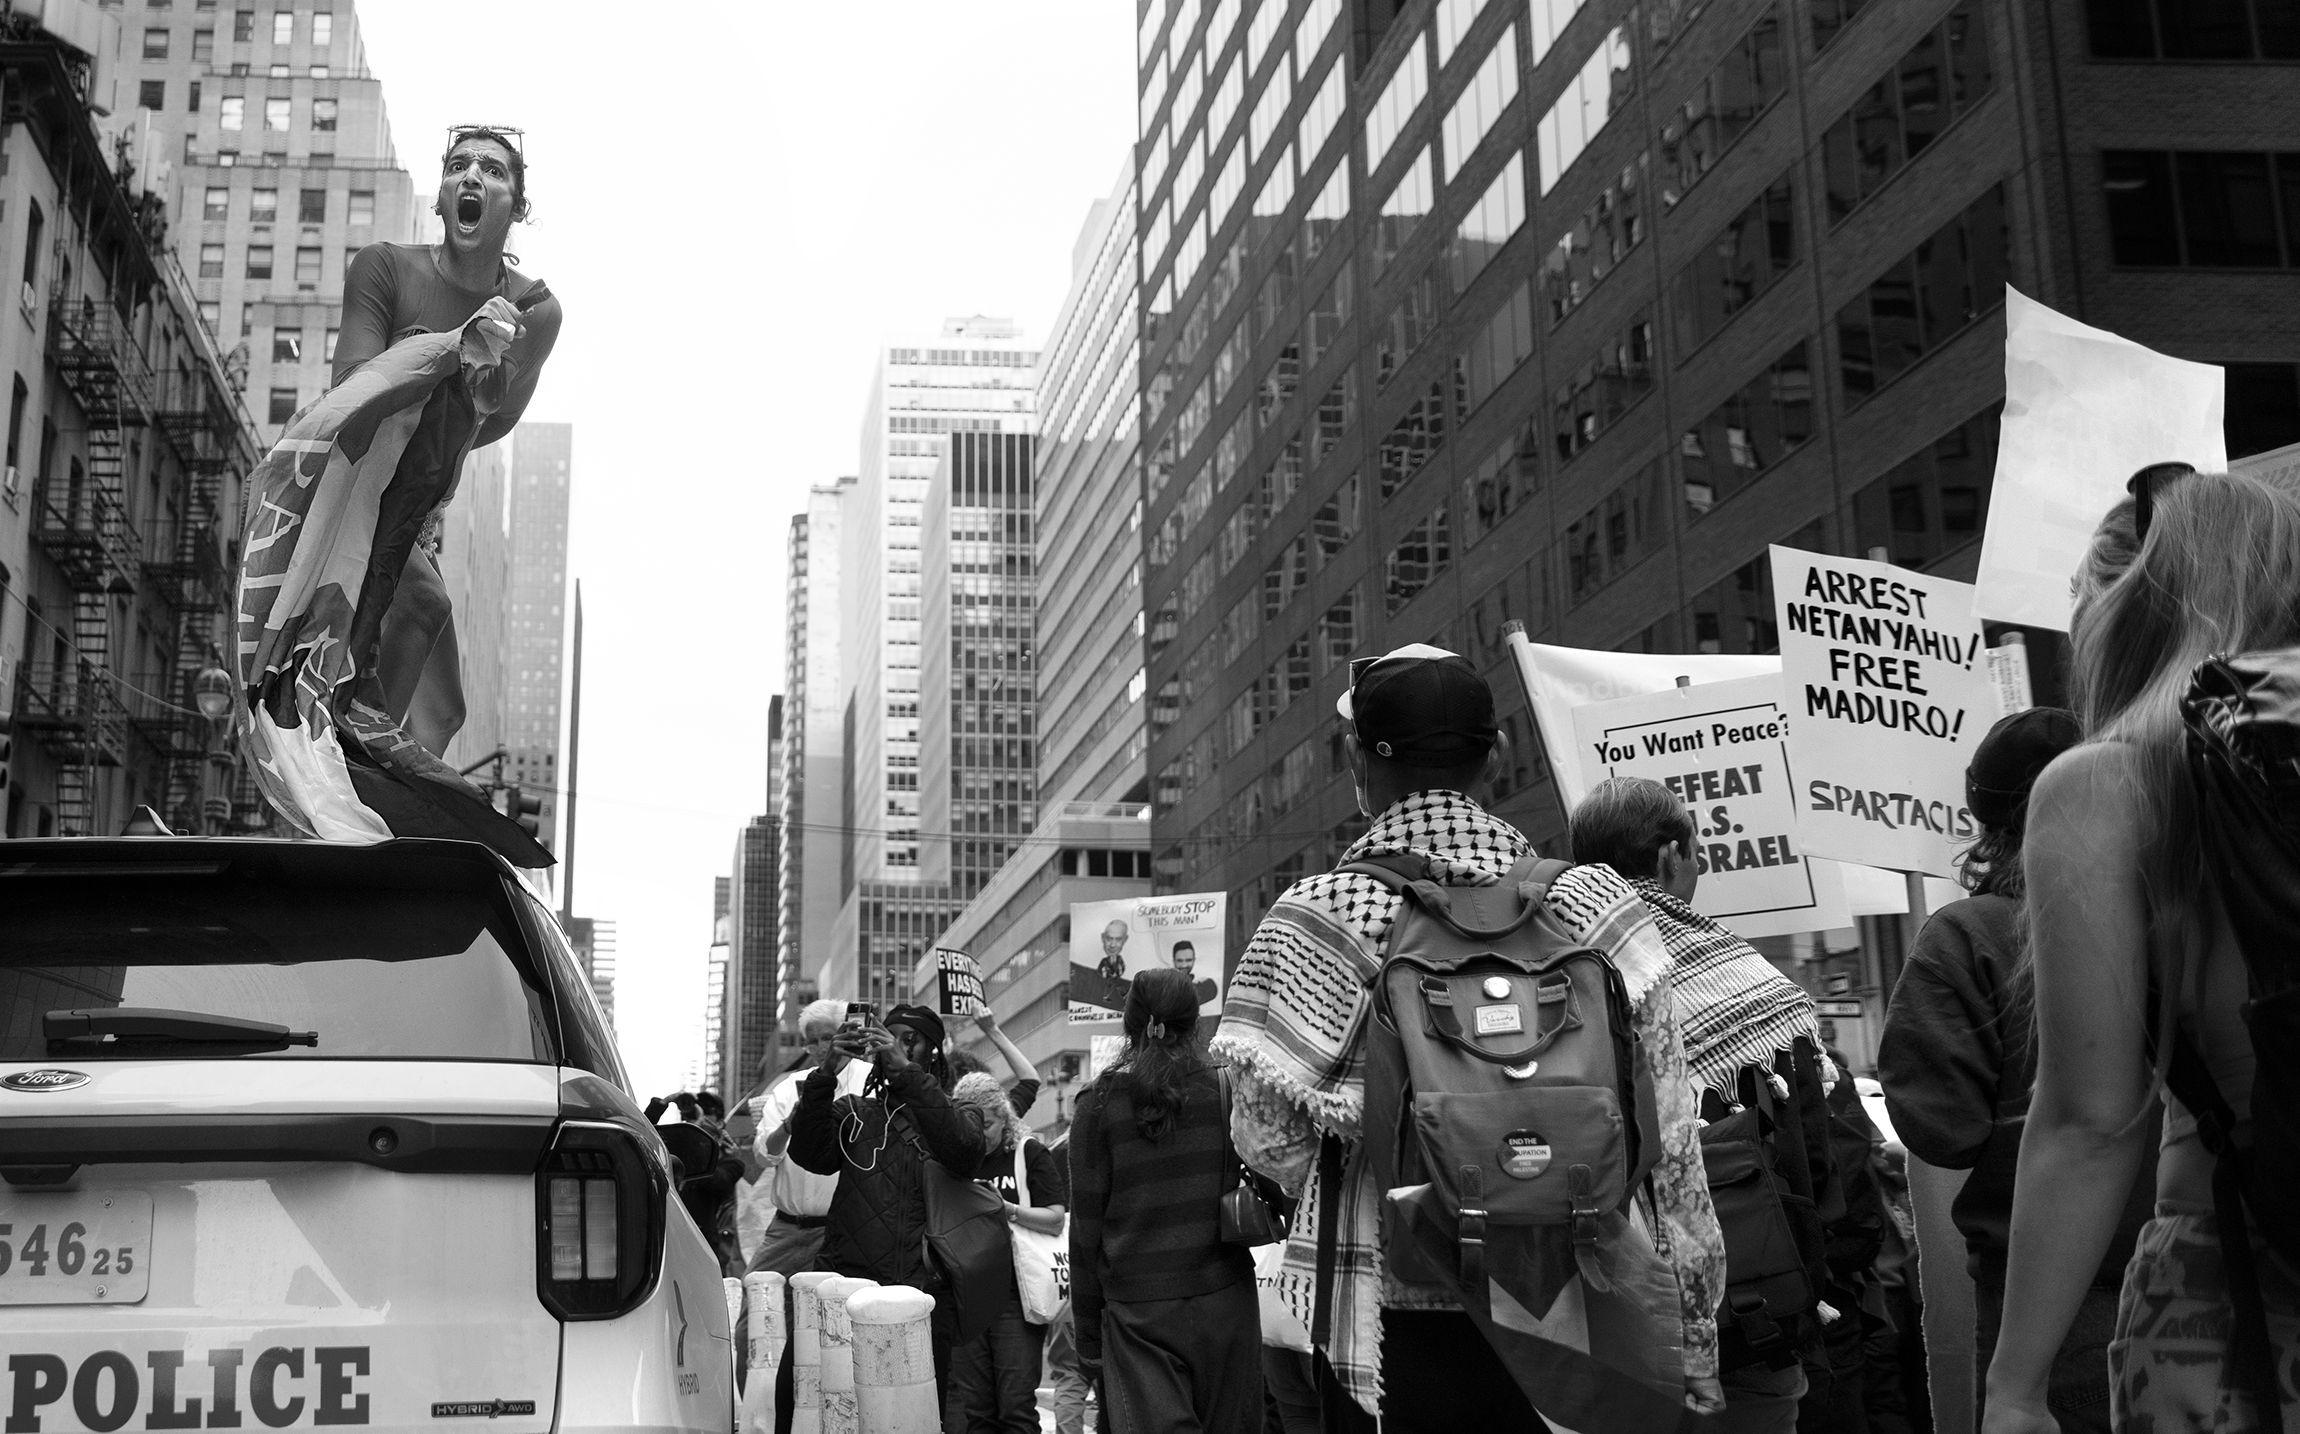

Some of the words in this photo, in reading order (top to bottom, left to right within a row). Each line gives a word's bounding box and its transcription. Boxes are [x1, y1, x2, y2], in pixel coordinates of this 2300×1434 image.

[1805, 566, 1927, 620] ARREST
[1787, 602, 1980, 671] NETANYAHU!
[1829, 648, 1928, 697] FREE
[1805, 684, 1965, 742] MADURO!
[1594, 741, 1635, 764] You
[1642, 729, 1704, 756] Want
[1183, 900, 1216, 914] STOP
[1148, 916, 1169, 928] THIS
[947, 972, 971, 994] HAS
[18, 1070, 70, 1084] Ford
[1524, 1137, 1537, 1145] THE
[91, 1247, 134, 1275] 25
[5, 1345, 371, 1433] POLICE
[436, 1404, 493, 1415] HYBRID
[507, 1403, 533, 1412] AWD
